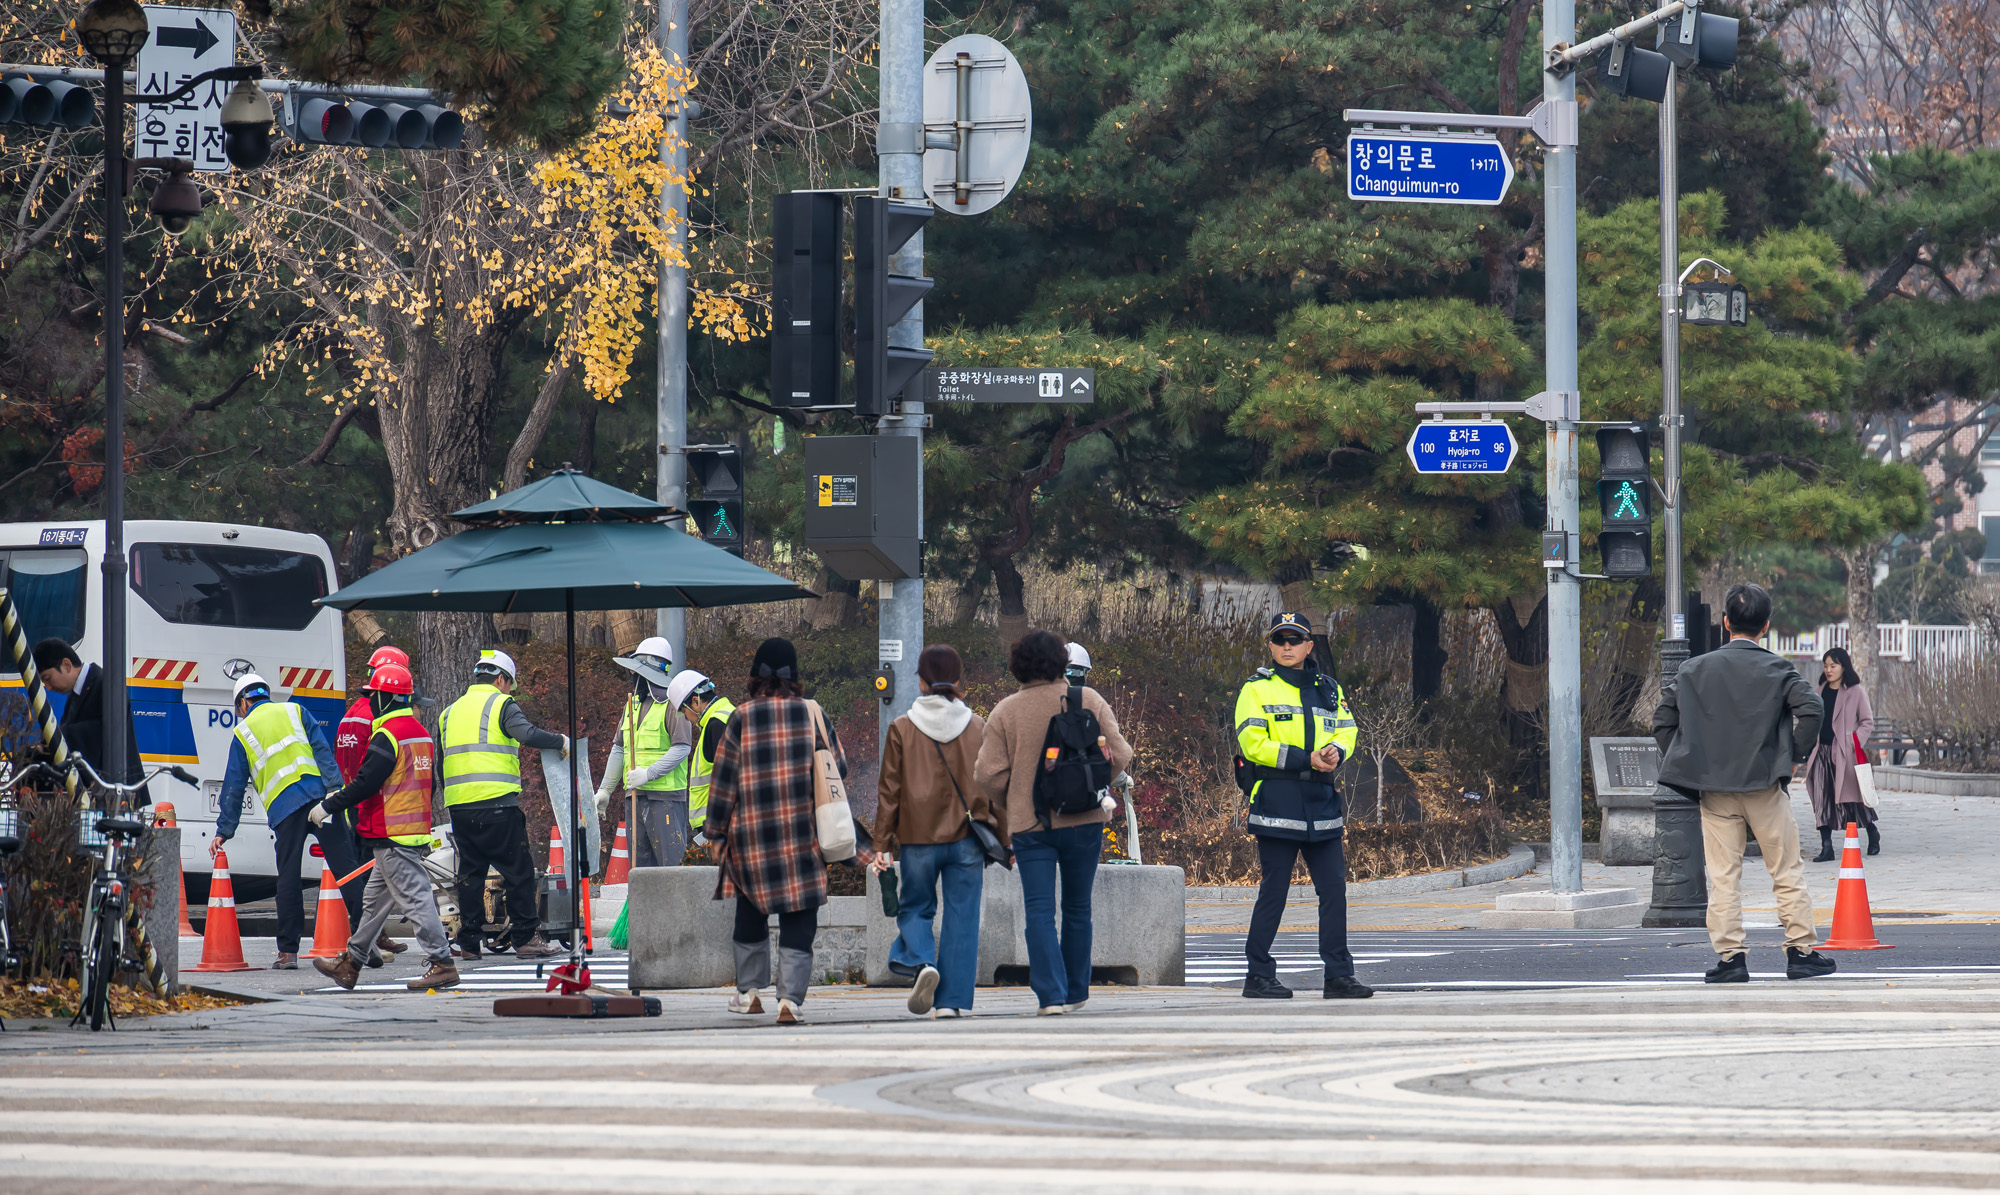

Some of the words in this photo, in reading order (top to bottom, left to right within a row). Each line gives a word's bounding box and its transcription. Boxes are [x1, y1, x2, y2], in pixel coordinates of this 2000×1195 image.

[142, 121, 226, 163] 우회전
[1355, 143, 1436, 171] 창의문로
[1355, 174, 1460, 195] Changuimun-ro
[1448, 428, 1480, 443] 효자로
[1420, 443, 1435, 453] 100
[1447, 447, 1480, 458] Hyoja-ro
[1493, 442, 1505, 453] 96
[42, 530, 85, 543] 16기동대-3
[337, 733, 358, 748] 신호수
[413, 756, 432, 770] 신호
